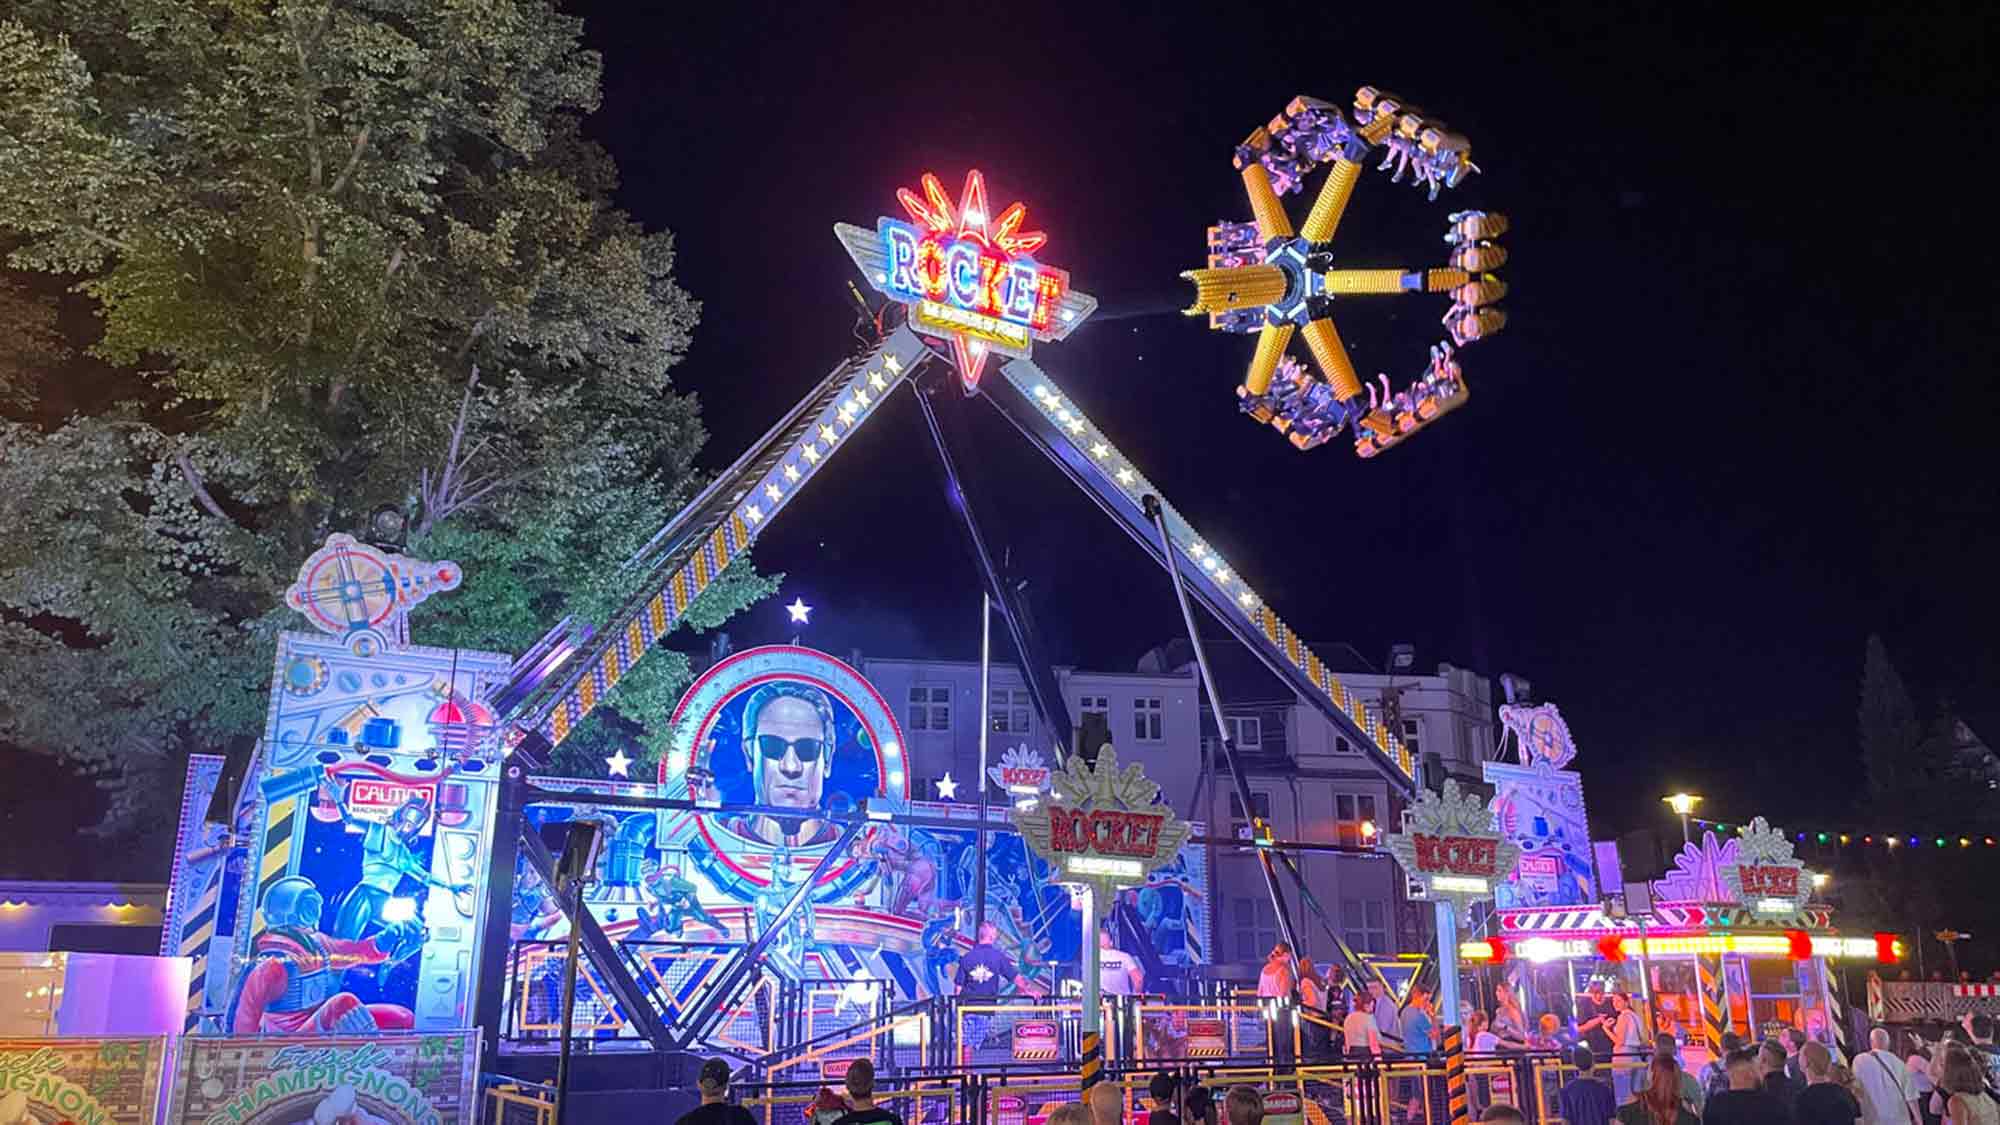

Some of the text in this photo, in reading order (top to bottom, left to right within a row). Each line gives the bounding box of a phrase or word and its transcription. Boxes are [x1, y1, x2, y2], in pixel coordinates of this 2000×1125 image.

[888, 226, 1063, 333] ROCKET
[1048, 806, 1164, 857] ROCKET
[1413, 832, 1498, 875] ROCKET
[1739, 864, 1799, 895] ROCKET
[268, 1042, 392, 1071] Frische
